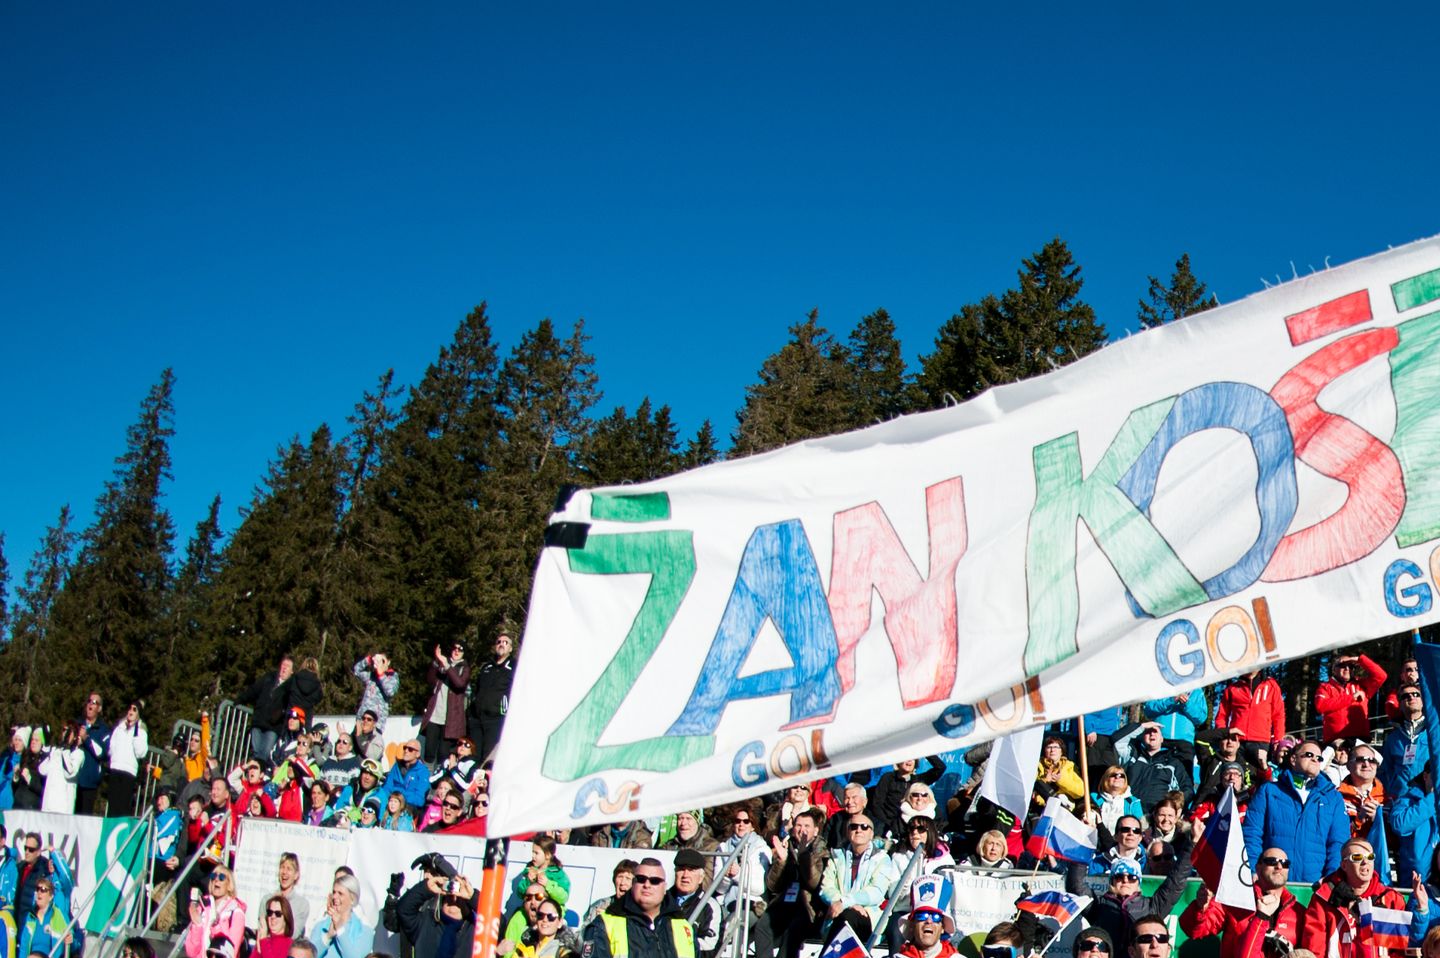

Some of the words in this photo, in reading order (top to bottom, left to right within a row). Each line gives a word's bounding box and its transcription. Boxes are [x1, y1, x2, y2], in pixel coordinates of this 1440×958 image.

[542, 474, 968, 783] ŽAN
[1153, 597, 1280, 687] GO!
[731, 728, 832, 788] GO!
